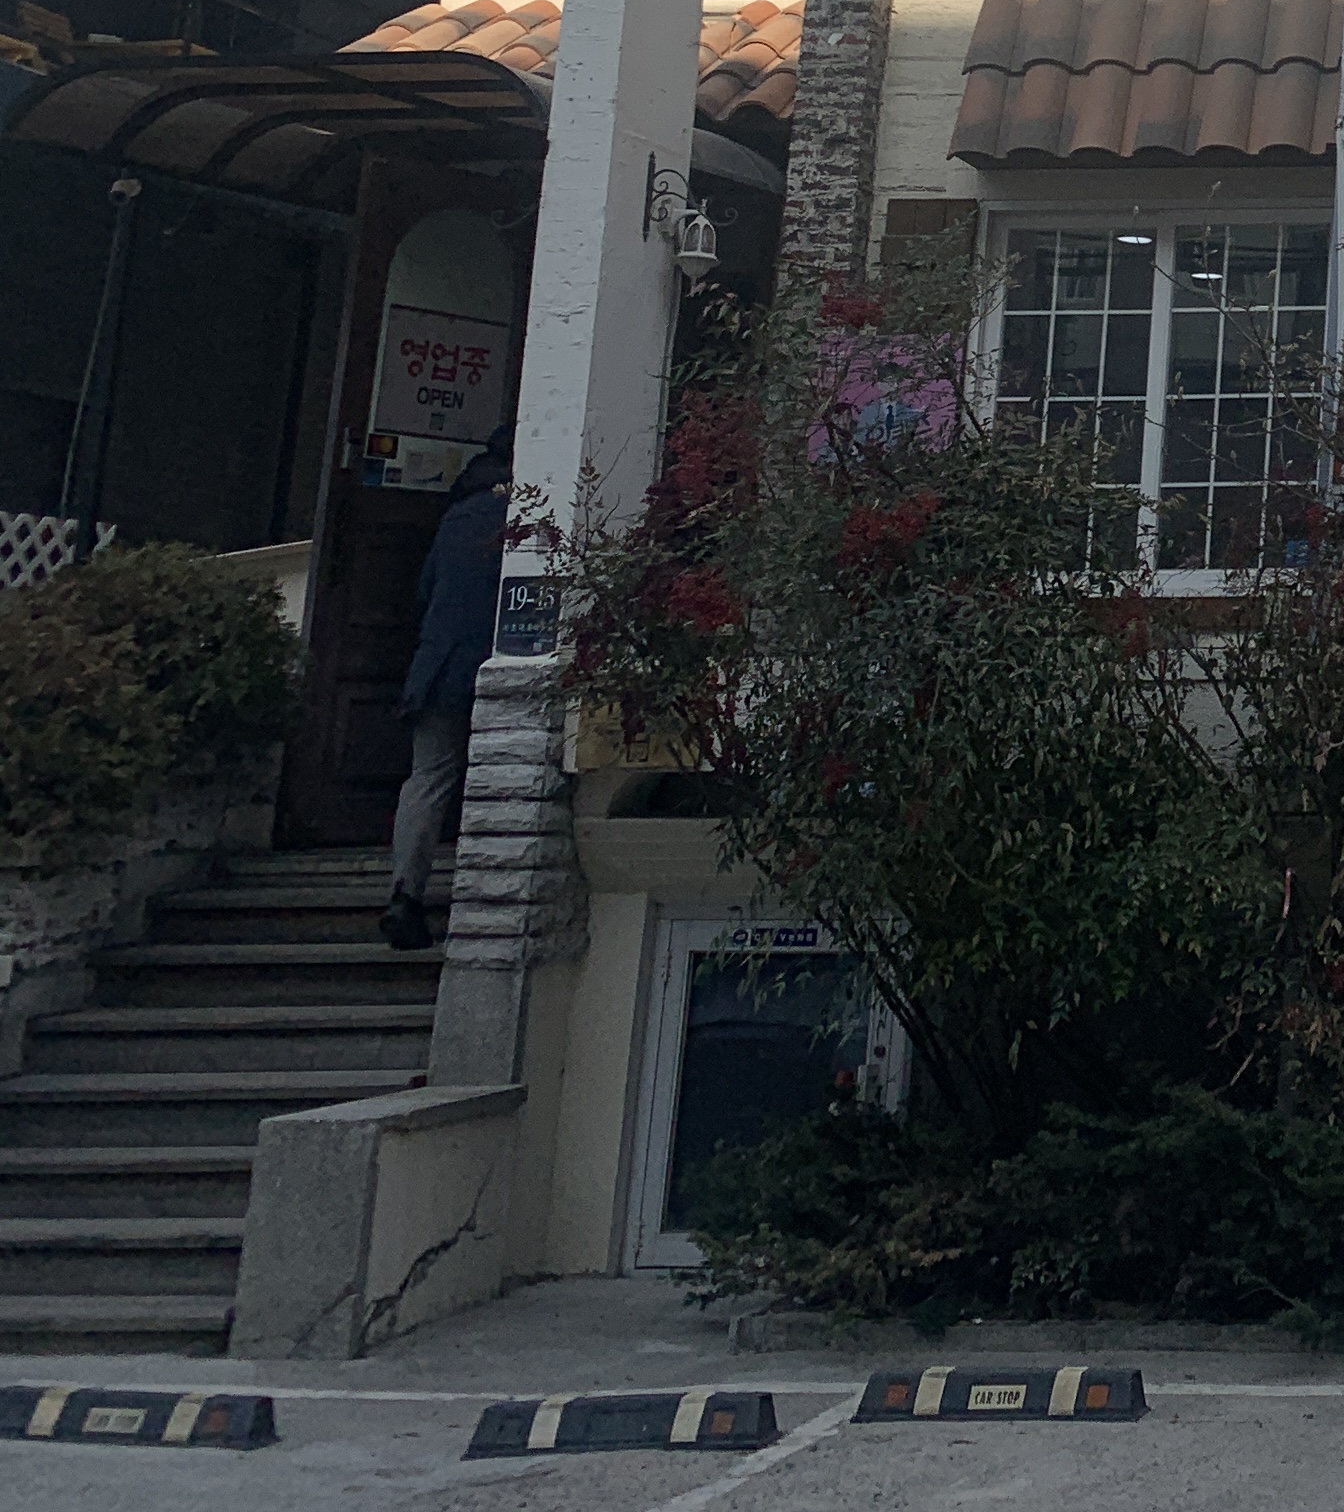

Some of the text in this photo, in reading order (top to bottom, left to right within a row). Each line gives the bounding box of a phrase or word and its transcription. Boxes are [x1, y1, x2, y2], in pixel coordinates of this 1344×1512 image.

[401, 338, 492, 386] 영업중
[417, 387, 465, 410] OPEN
[975, 1391, 1020, 1405] CAR STOP
